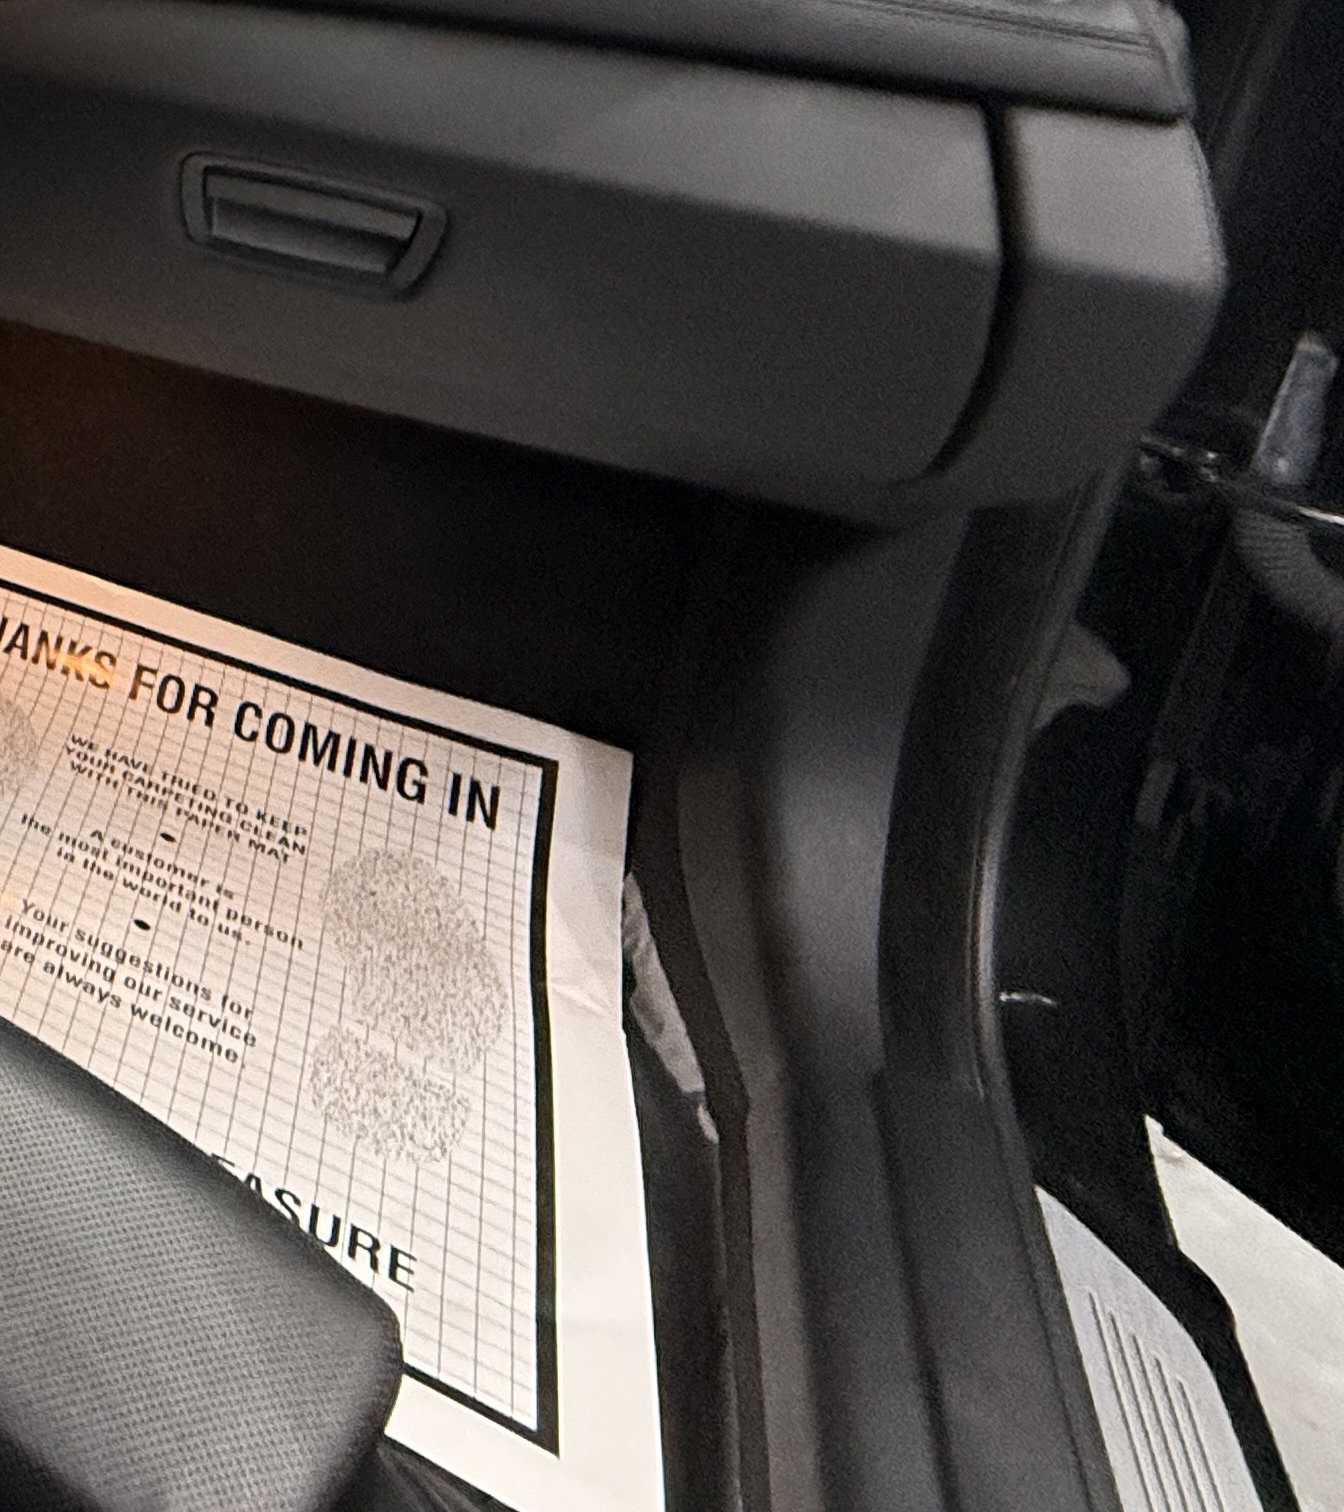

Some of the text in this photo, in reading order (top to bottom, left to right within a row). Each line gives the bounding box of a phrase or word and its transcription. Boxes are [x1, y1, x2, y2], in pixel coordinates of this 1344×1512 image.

[64, 745, 307, 856] YOUR CARPETING CLEAN
[71, 734, 309, 836] WE HAVE TRIED TO KEEP
[128, 663, 218, 728] FOR
[233, 700, 429, 803] COMING
[447, 771, 502, 832] IN
[69, 760, 292, 865] WITH THIS PAPER MAT
[89, 829, 235, 901] A customer is
[20, 813, 305, 951] the most important person
[56, 846, 252, 947] in the world to us.
[0, 938, 247, 1069] are always welcome.
[4, 914, 257, 1048] improving our service
[20, 898, 255, 1019] Your suggestions for
